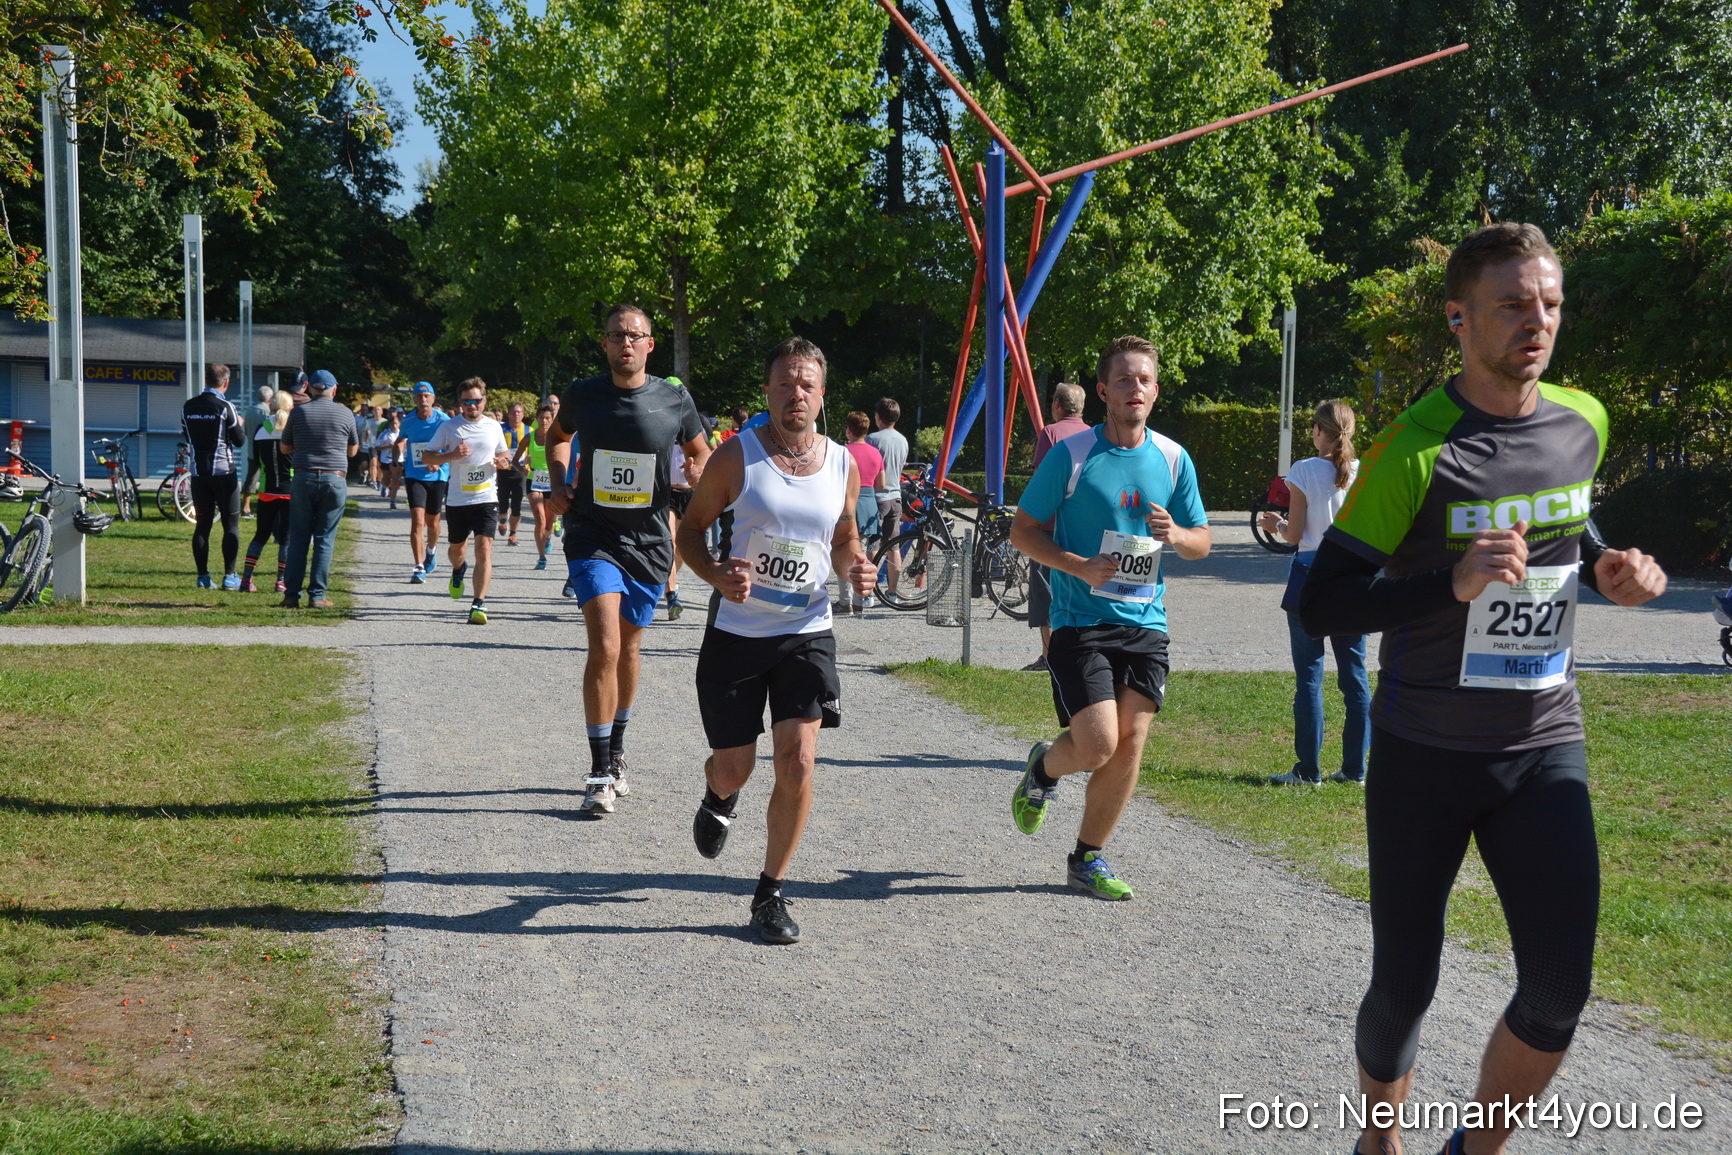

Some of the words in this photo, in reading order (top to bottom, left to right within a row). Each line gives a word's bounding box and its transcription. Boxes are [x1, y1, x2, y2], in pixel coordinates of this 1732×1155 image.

[85, 366, 124, 380] CAFE
[132, 368, 177, 382] KIOSK
[467, 470, 485, 482] 329
[611, 467, 635, 486] 50
[609, 493, 635, 503] Marcel
[1450, 485, 1590, 534] BOCK
[1123, 541, 1150, 550] BOCK
[755, 552, 809, 583] 3092
[1117, 584, 1137, 596] Rene
[1486, 599, 1568, 638] 2527
[1492, 642, 1520, 651] PARTL
[1503, 659, 1549, 675] Martin
